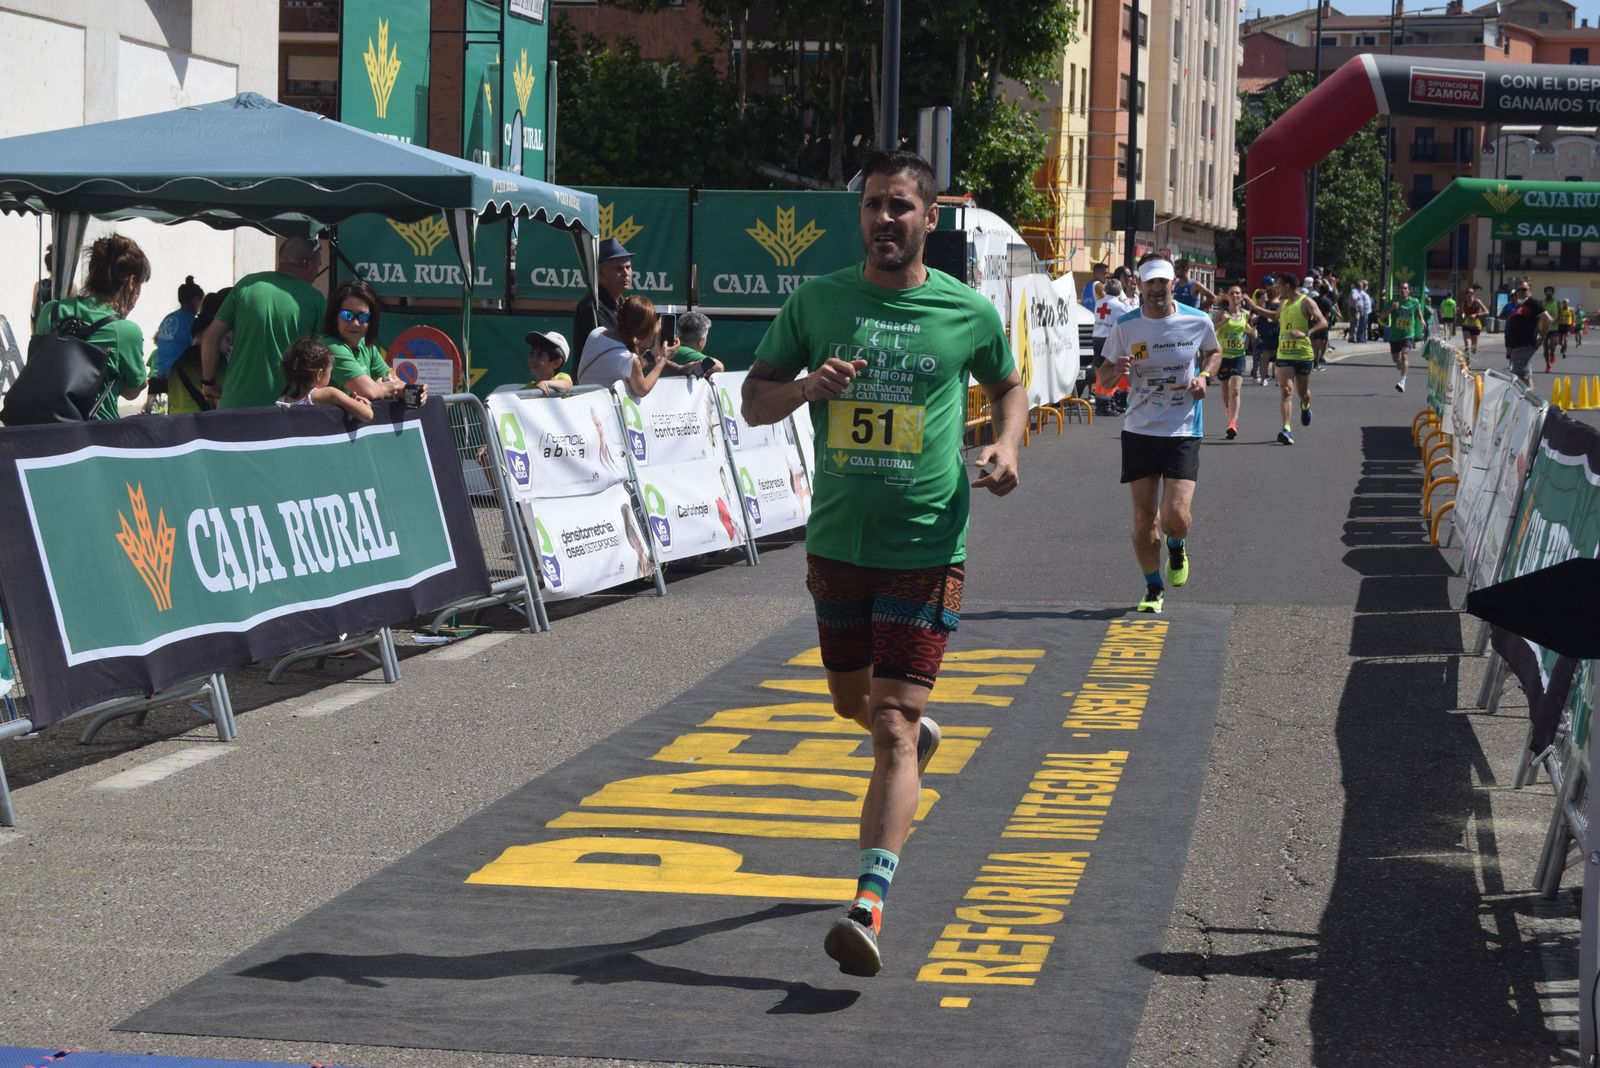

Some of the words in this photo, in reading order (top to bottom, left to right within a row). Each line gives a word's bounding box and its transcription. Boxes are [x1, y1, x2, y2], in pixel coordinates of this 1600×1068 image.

[1469, 83, 1479, 91] DE
[1500, 74, 1537, 88] CON
[1542, 77, 1562, 91] EL
[1427, 89, 1479, 102] ZAMORA
[1499, 95, 1583, 113] GANAMOS
[1523, 191, 1571, 209] CAJA
[1572, 192, 1600, 208] RU
[1516, 223, 1600, 238] SALIDA
[354, 262, 407, 283] CAJA
[530, 267, 587, 288] CAJA
[628, 272, 674, 292] RAL
[713, 274, 770, 294] CAJA
[875, 320, 920, 334] CARRERA
[869, 369, 914, 383] ZAMORA
[856, 392, 879, 401] CAJA
[880, 394, 913, 404] RURAL
[851, 407, 894, 446] 51
[849, 456, 876, 467] CAJA
[878, 458, 915, 470] RURAL
[187, 505, 287, 594] CAJA
[277, 487, 401, 578] RURAL
[1086, 619, 1170, 679] INTERIORES
[1062, 683, 1152, 730] DISEÑO
[1000, 750, 1130, 841] INTEGRAL
[916, 851, 1091, 986] REFORMA
